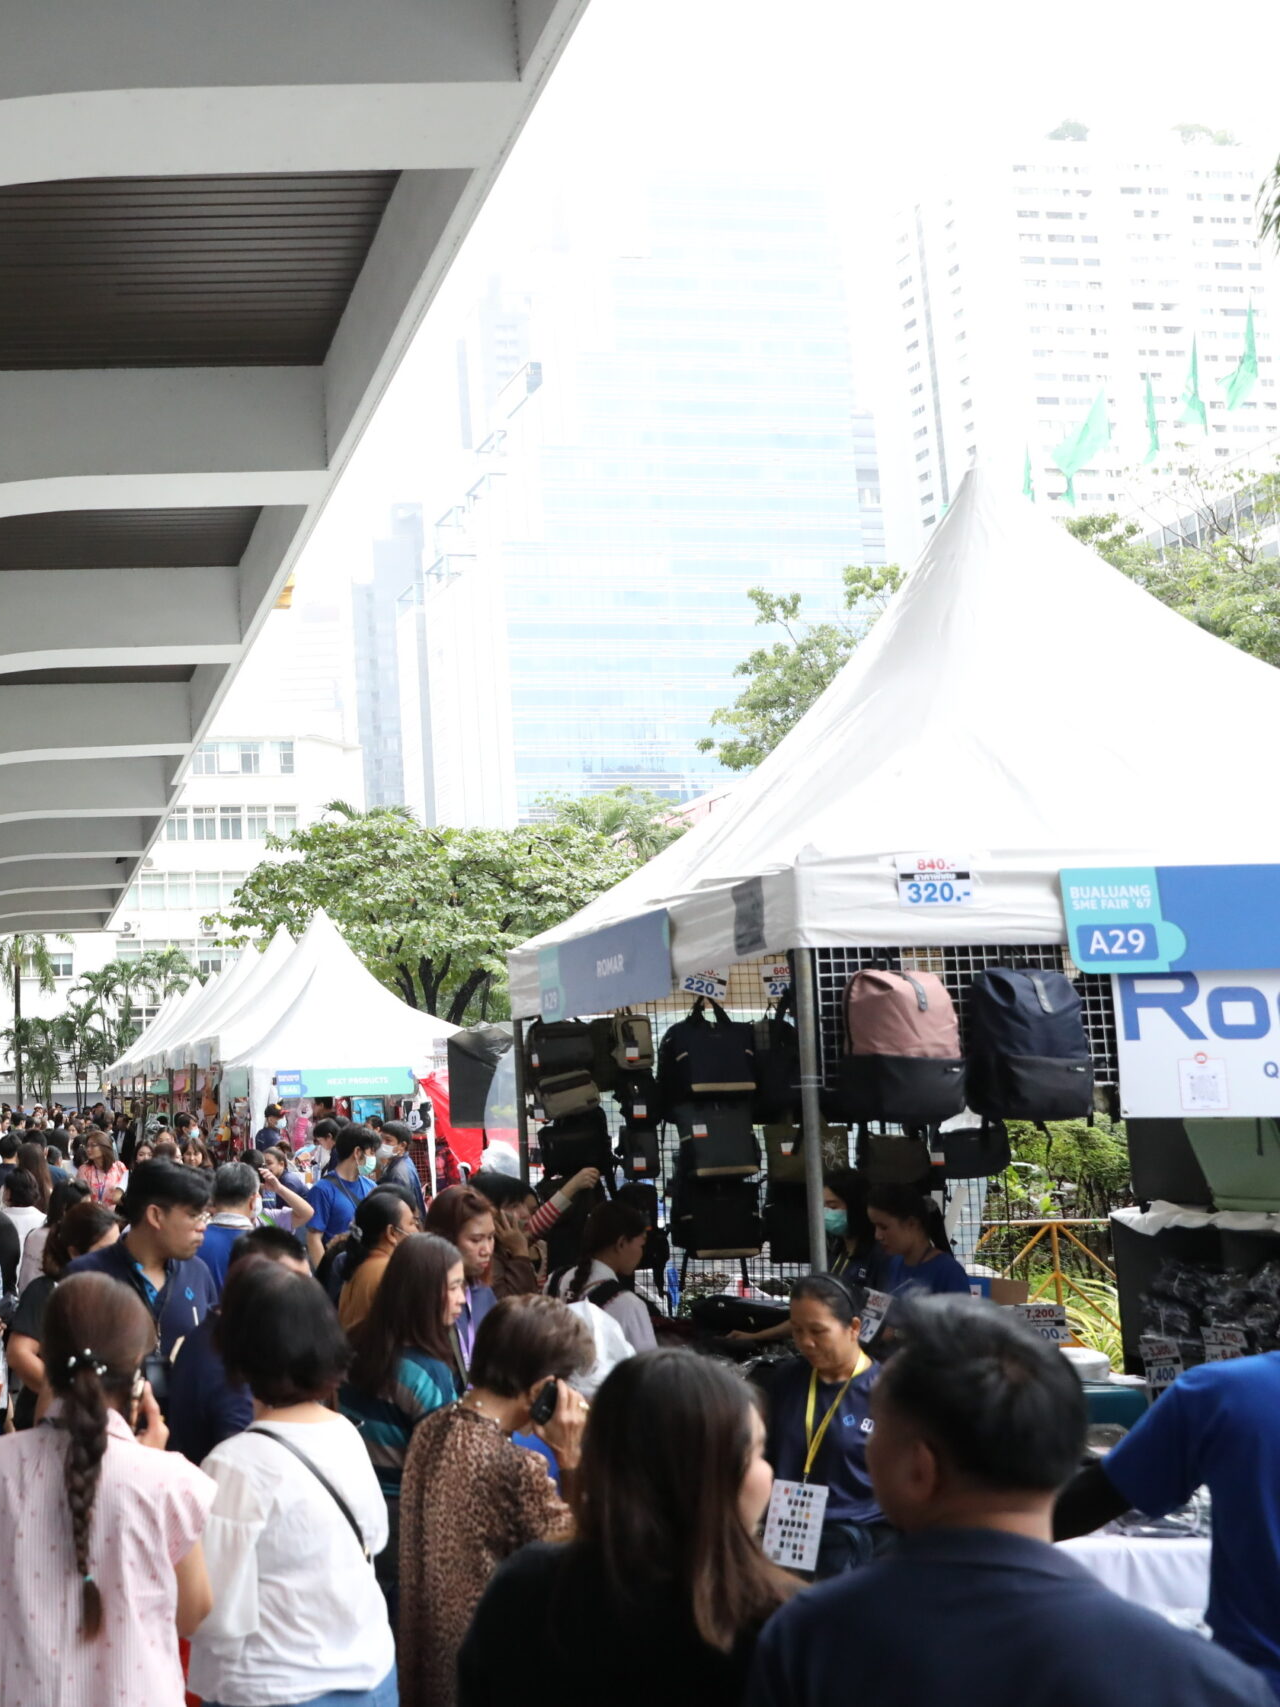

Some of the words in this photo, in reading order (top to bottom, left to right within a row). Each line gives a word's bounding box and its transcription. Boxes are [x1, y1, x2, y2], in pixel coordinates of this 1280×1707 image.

[917, 859, 956, 871] 840.-
[907, 882, 971, 903] 320.-
[1070, 885, 1151, 899] BUALUANG
[1072, 898, 1098, 910] SME
[1101, 897, 1129, 910] FAIR
[1132, 897, 1152, 909] '67
[1089, 929, 1146, 954] A29
[596, 953, 625, 978] ROMAR
[684, 977, 725, 997] 220.-
[768, 982, 791, 996] 22
[1120, 971, 1280, 1041] Ro
[326, 1077, 347, 1085] NEXT
[347, 1076, 389, 1085] PRODUCTS
